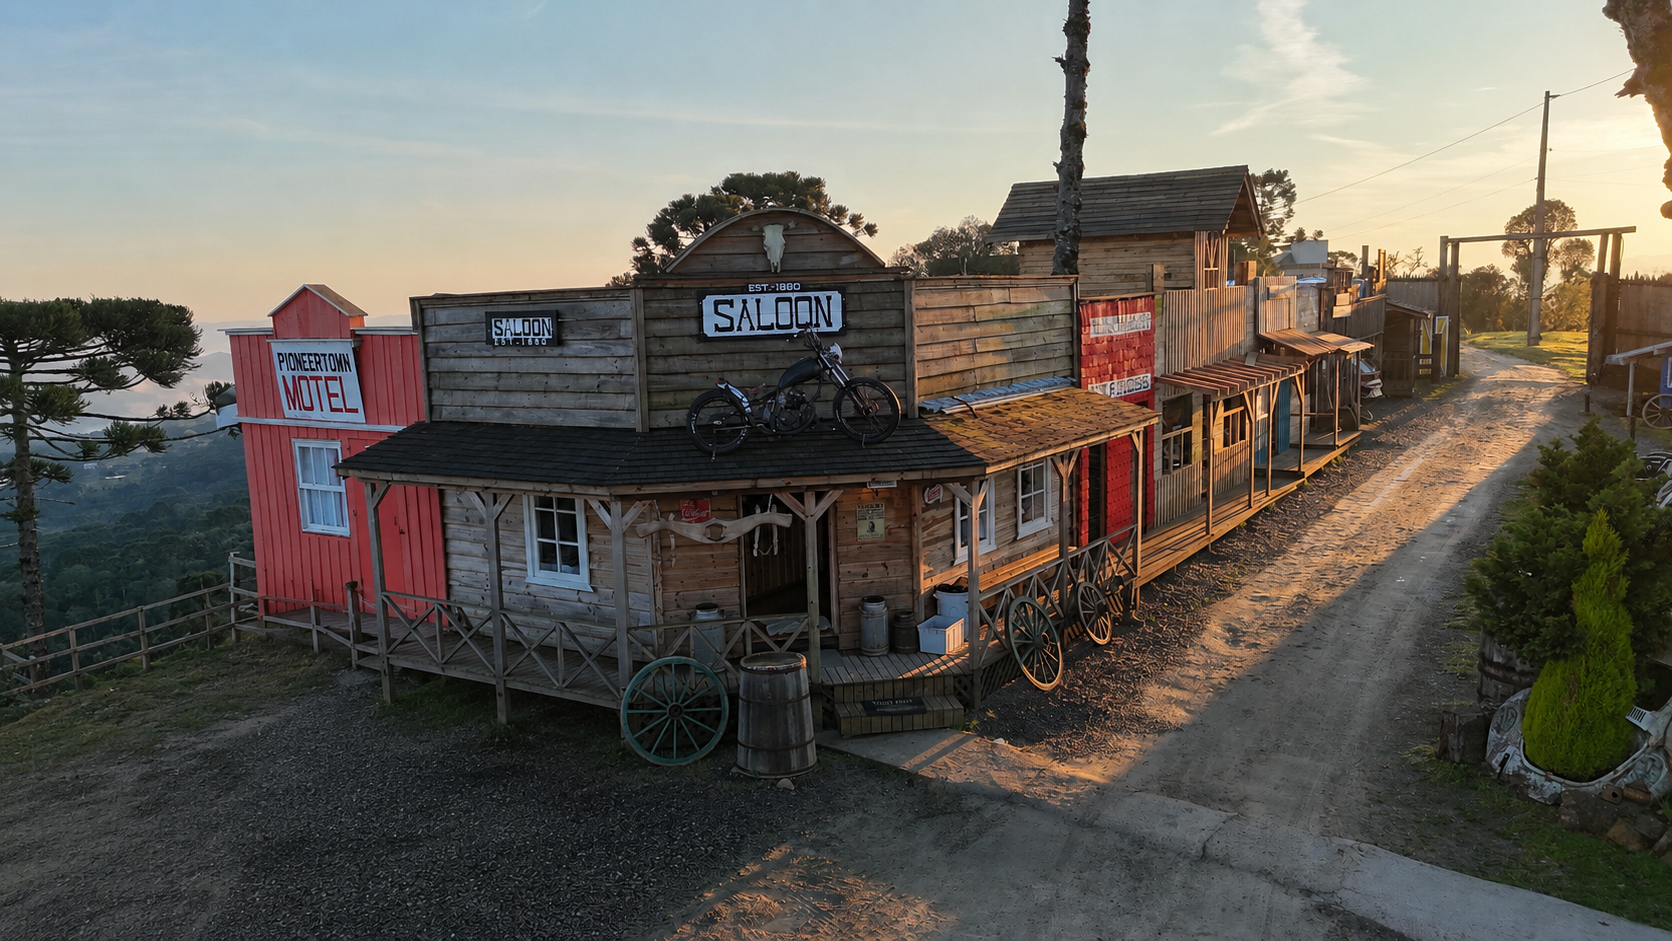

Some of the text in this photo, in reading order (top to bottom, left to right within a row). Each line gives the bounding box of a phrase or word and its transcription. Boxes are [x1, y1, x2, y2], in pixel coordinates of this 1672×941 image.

[493, 318, 552, 337] SALOON
[713, 295, 833, 333] SALOON
[277, 352, 352, 373] PIONEERTOWN
[282, 375, 359, 413] MOTEL
